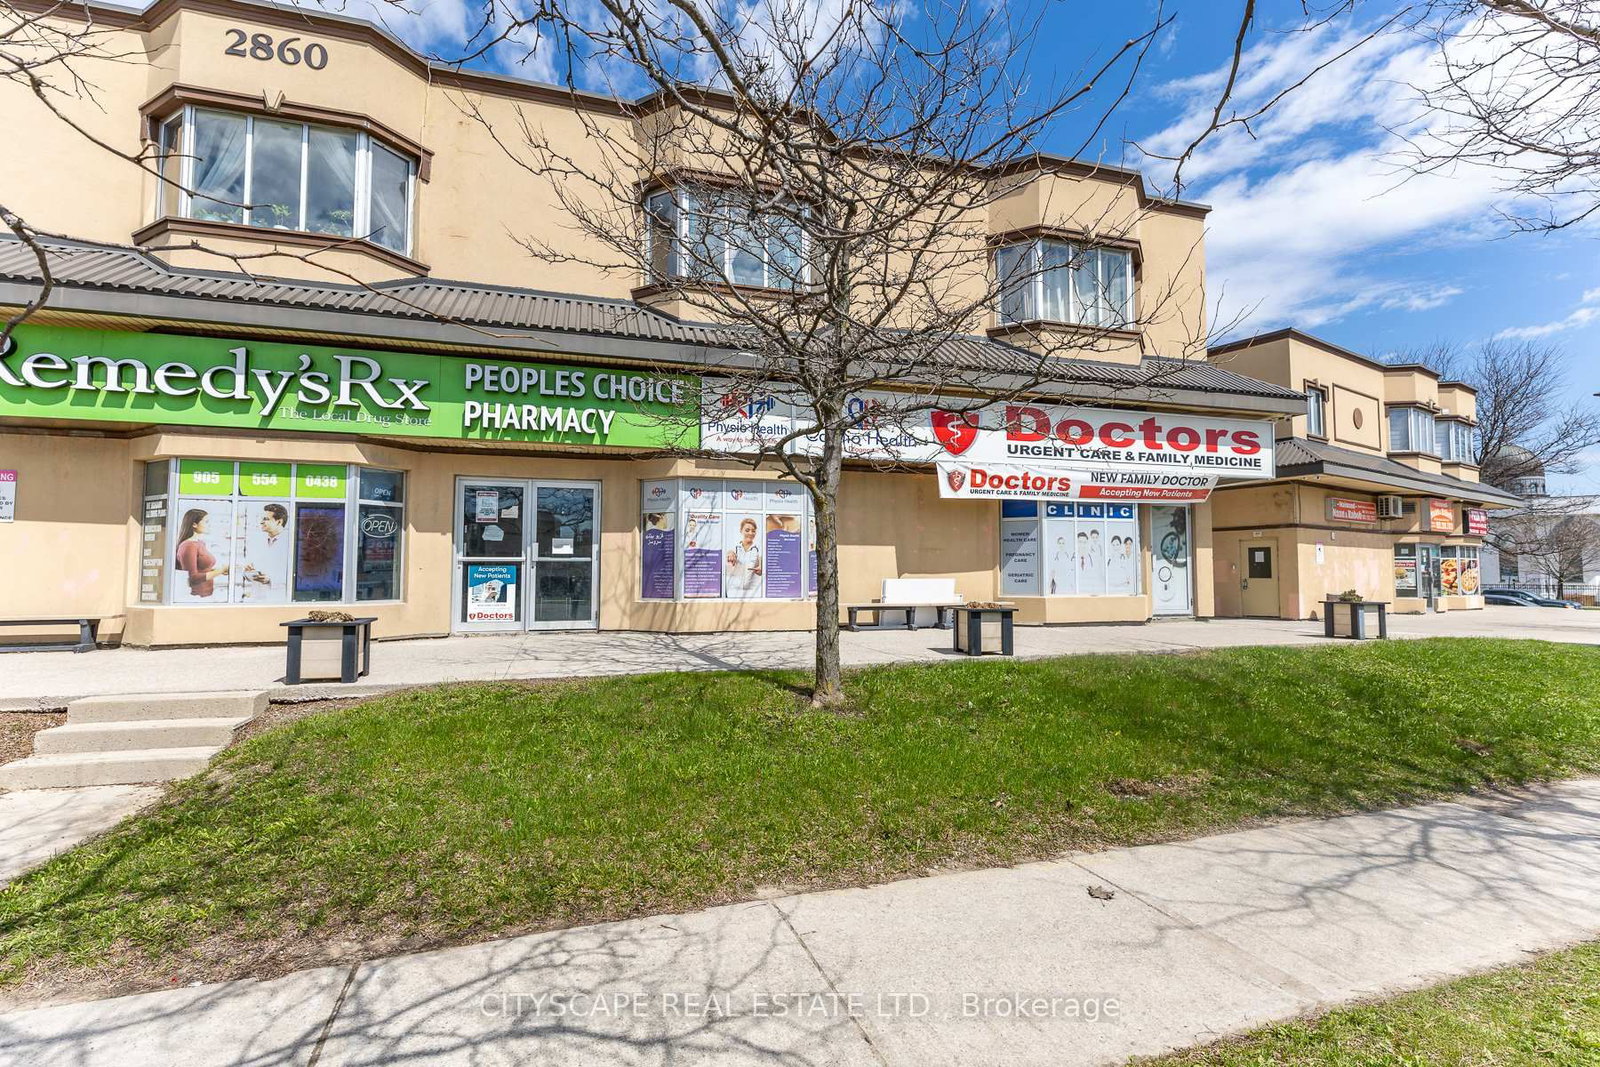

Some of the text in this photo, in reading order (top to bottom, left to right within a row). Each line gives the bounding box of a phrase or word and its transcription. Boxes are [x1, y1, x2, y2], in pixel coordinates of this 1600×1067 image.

[225, 28, 328, 70] 2860
[465, 363, 685, 404] PEOPLES CHOICE
[280, 407, 432, 428] The Local Drug Store
[464, 401, 616, 434] PHARMACY
[1006, 405, 1262, 455] Doctors
[1007, 444, 1262, 467] URGENT CARE & FAMILY MEDICINE
[193, 471, 338, 488] 905 554 0438
[970, 468, 1071, 491] Doctors
[1091, 472, 1209, 487] NEW FAMILY DOCTOR
[374, 487, 392, 496] OPEN
[1100, 488, 1193, 498] Accepting New Patients
[1047, 505, 1130, 516] CLINIC
[363, 520, 394, 532] OPEN
